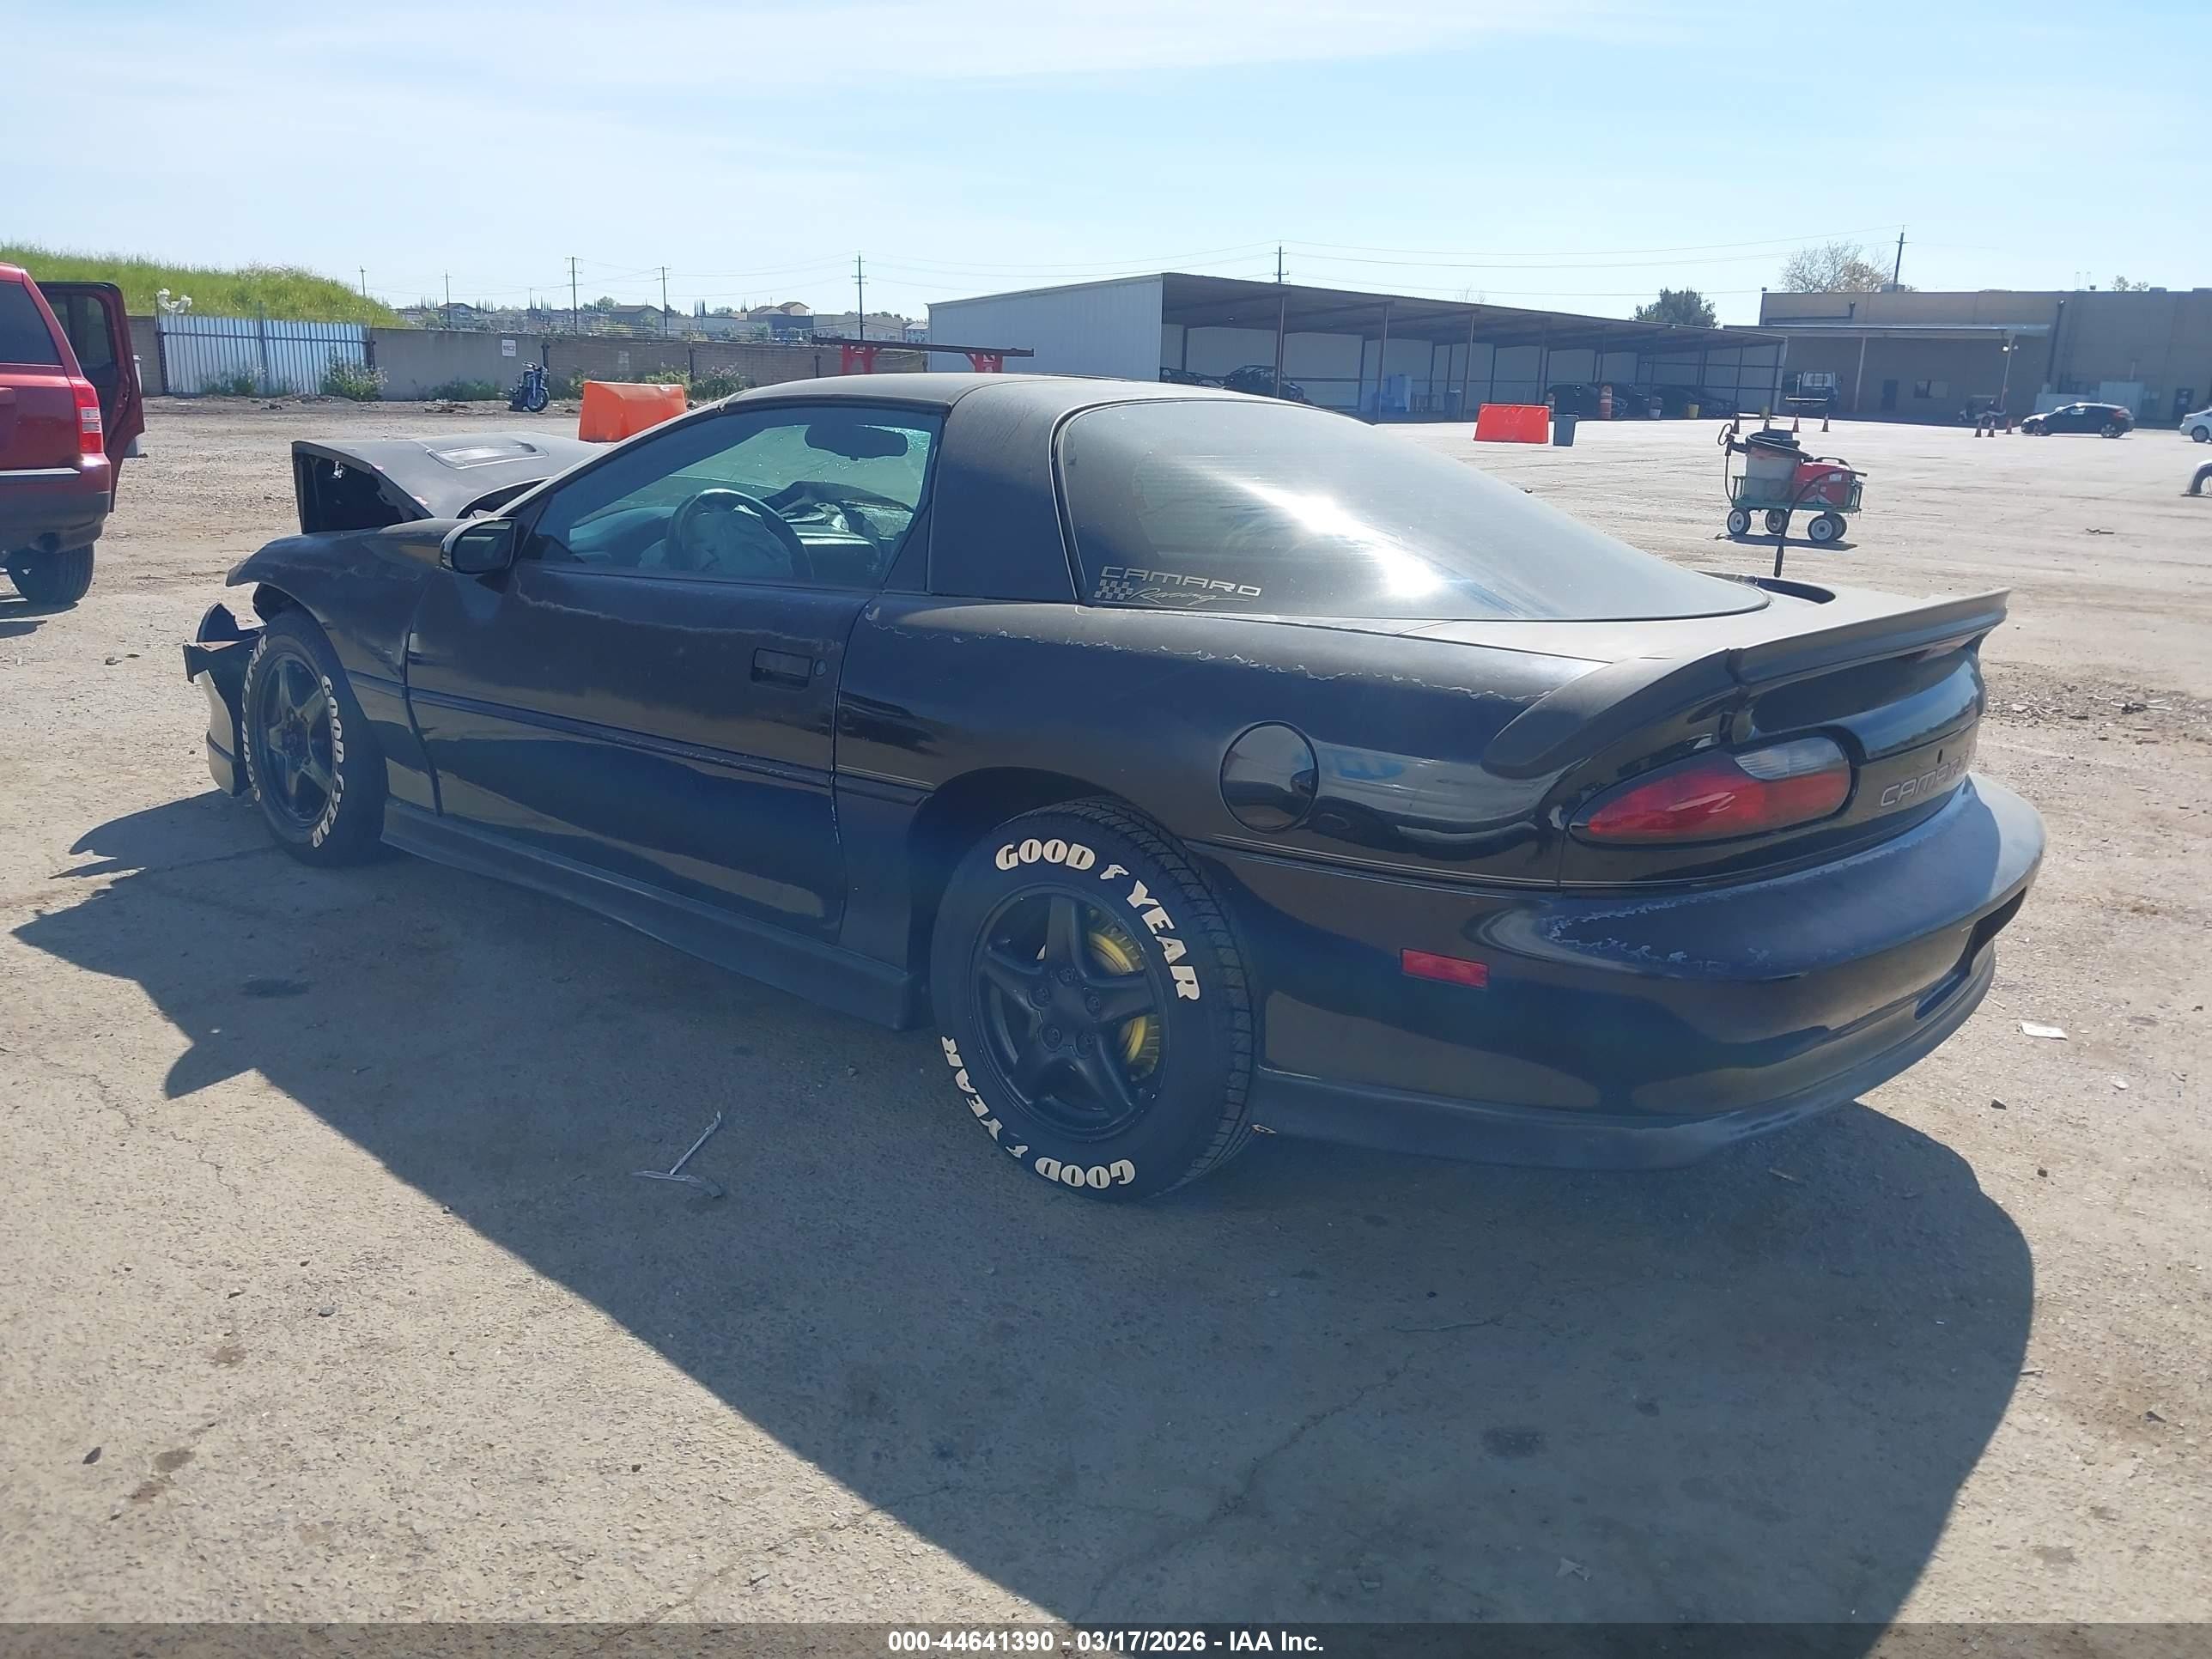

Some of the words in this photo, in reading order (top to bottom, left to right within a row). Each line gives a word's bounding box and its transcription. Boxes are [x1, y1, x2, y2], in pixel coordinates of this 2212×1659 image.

[1100, 566, 1261, 597] CAMARO
[1127, 586, 1250, 606] Racing
[321, 675, 344, 763] GOOD
[995, 838, 1096, 871] GOOD
[1126, 879, 1200, 1000] YEAR
[941, 1036, 1003, 1142] YEAR
[1035, 1158, 1135, 1189] GOOD
